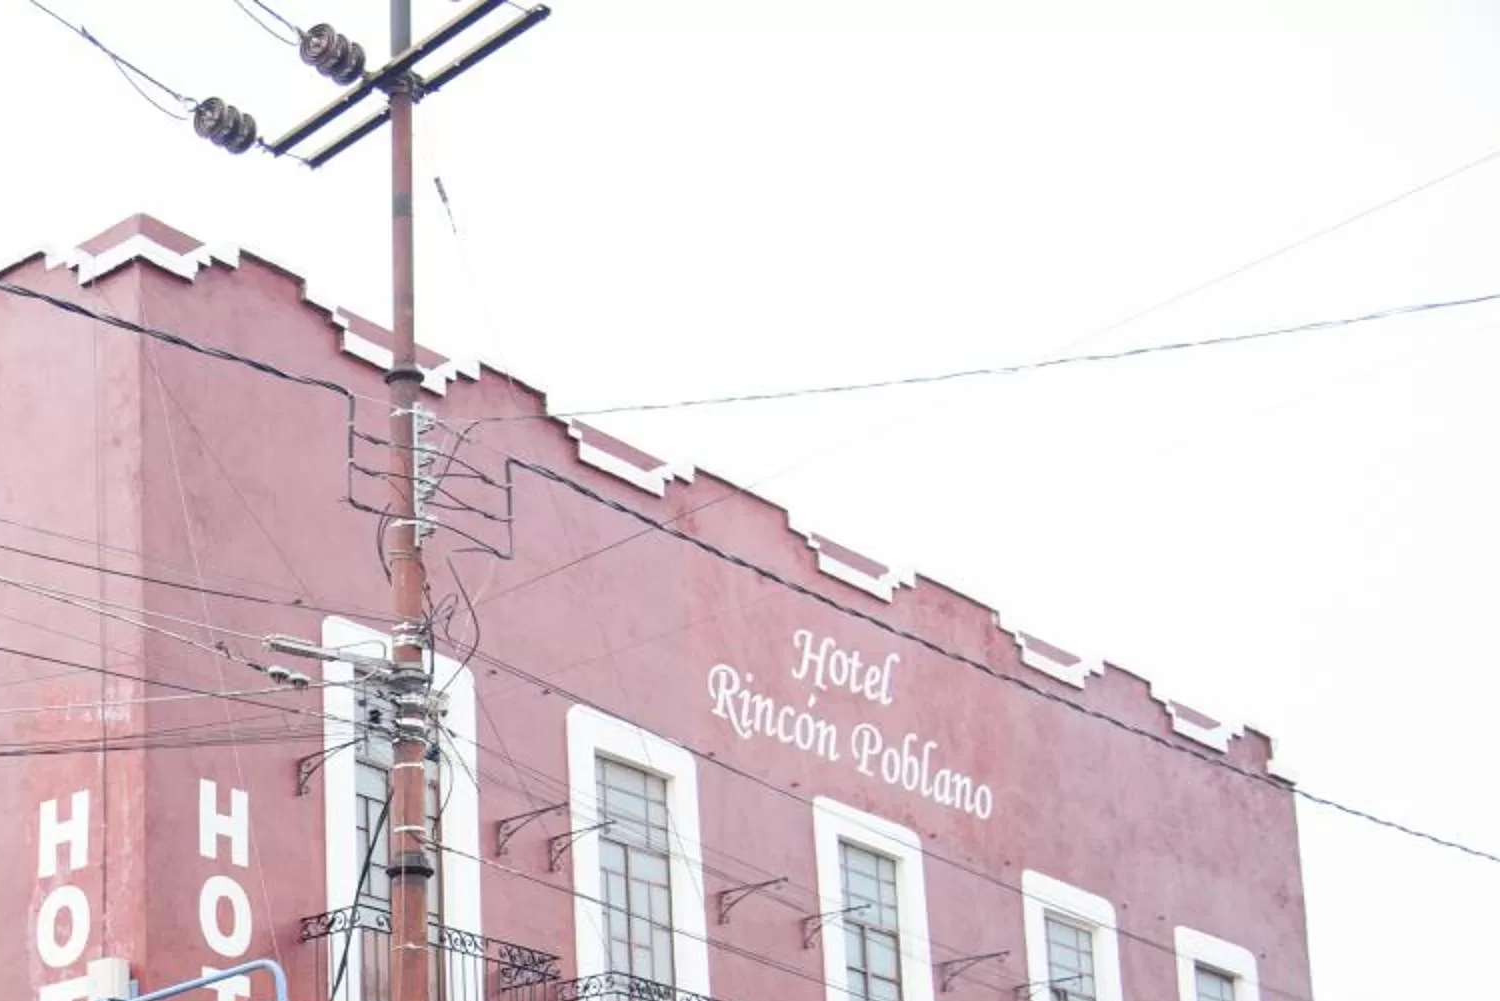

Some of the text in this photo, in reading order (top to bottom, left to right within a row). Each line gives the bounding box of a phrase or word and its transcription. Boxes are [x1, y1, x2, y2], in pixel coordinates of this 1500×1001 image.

[793, 629, 900, 705] Hotel
[707, 663, 994, 820] Rincón Poblano
